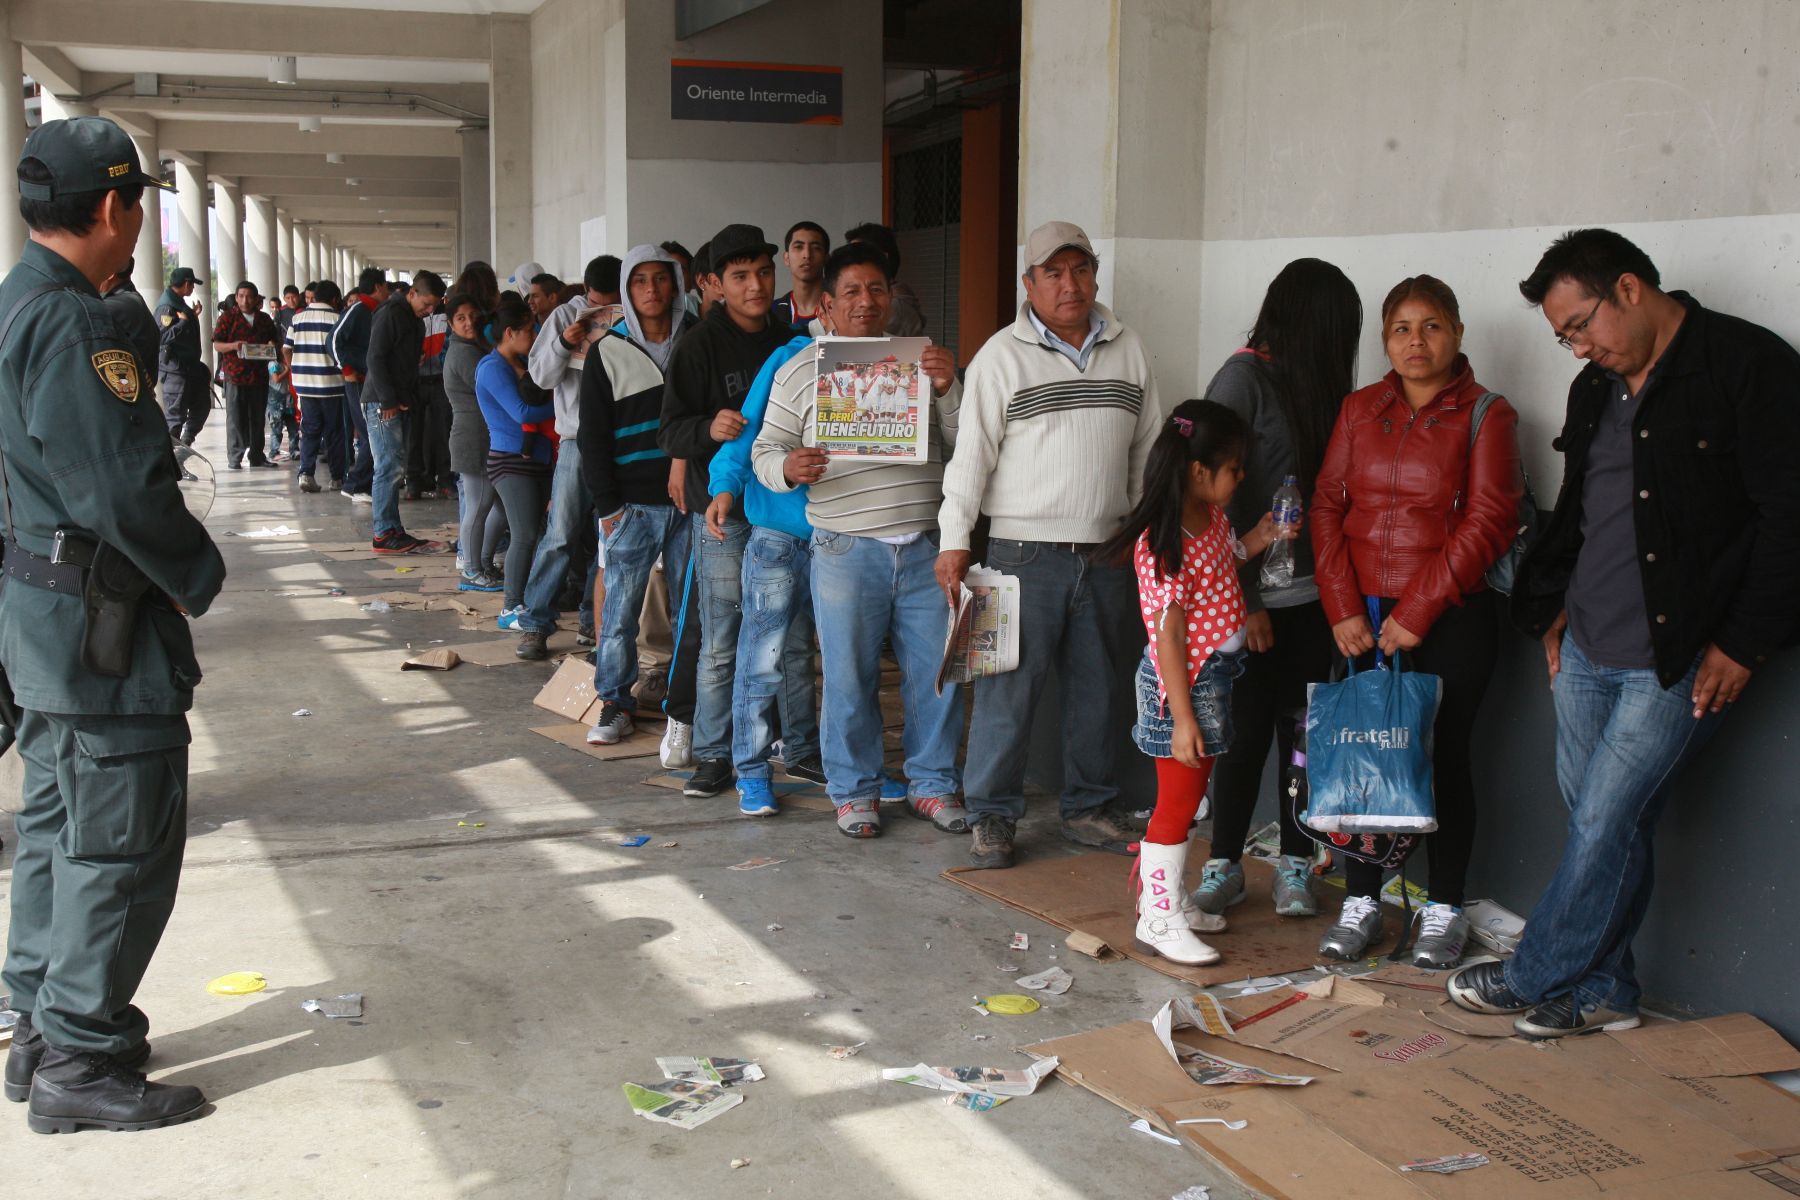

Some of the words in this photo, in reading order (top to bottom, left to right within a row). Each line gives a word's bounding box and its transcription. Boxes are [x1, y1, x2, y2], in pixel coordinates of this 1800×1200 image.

[687, 84, 745, 101] Oriente
[750, 88, 827, 104] Intermedia
[97, 352, 132, 364] AGUILAS
[818, 412, 828, 422] EL
[818, 422, 857, 437] TIENE
[859, 423, 914, 438] FUTURO
[1340, 727, 1409, 744] fratelli
[1454, 1106, 1481, 1122] FUN
[1467, 1124, 1505, 1146] STOCK
[1506, 1127, 1541, 1146] EACH
[1501, 1144, 1565, 1180] CUSTOMER
[1510, 1161, 1550, 1183] ITEM
